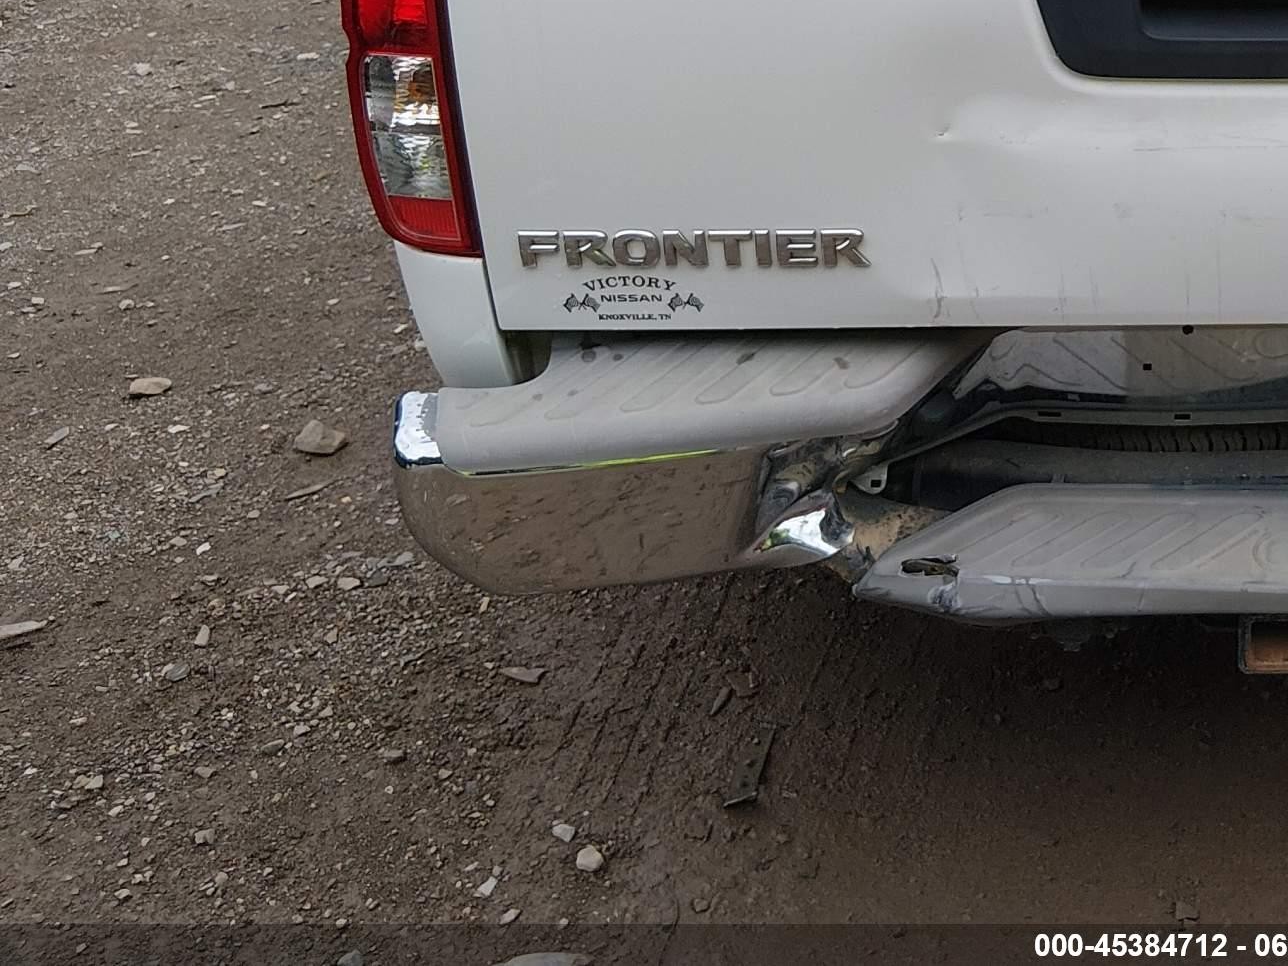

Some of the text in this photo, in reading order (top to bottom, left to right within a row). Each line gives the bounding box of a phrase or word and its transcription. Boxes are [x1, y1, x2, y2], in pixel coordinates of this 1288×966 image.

[517, 229, 872, 268] FRONTIER
[582, 275, 676, 291] VICTORY
[600, 294, 662, 302] NISSAN
[598, 313, 657, 321] KNOXVILLE,
